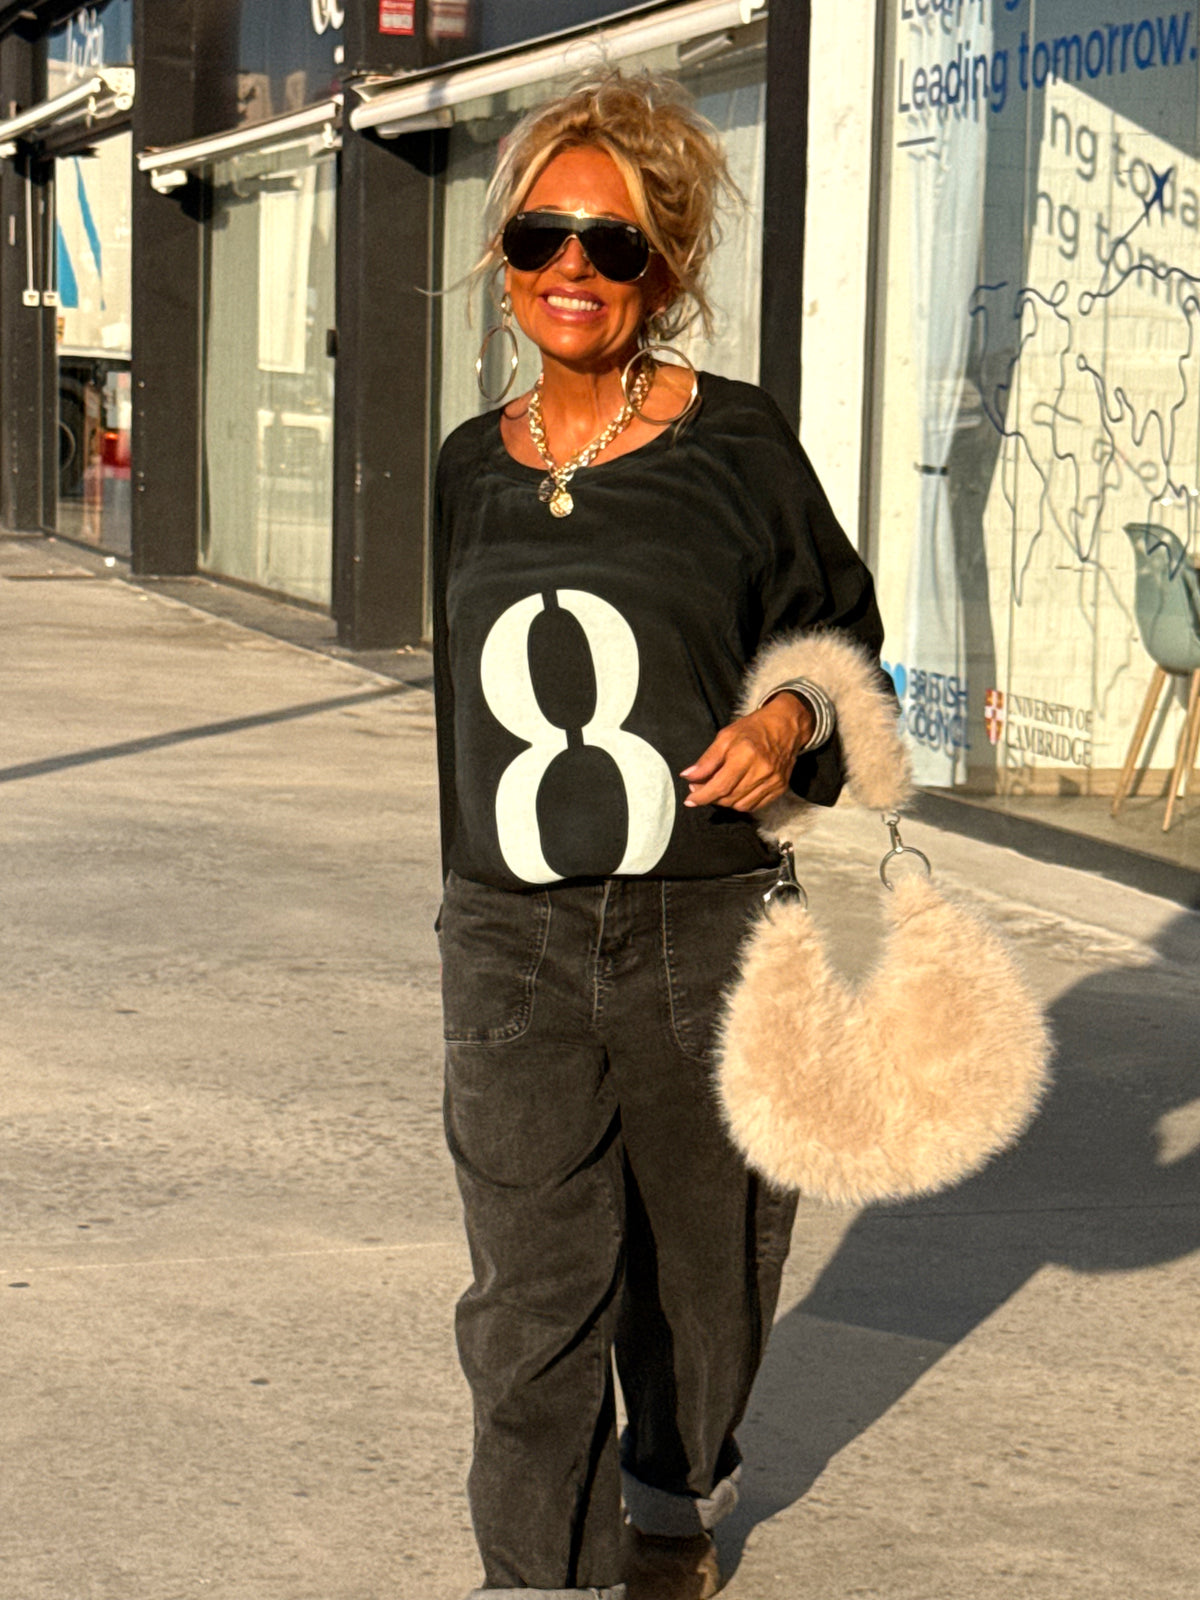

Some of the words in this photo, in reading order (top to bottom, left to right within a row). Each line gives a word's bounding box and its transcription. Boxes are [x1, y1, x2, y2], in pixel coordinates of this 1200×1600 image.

[898, 40, 1008, 113] Leading
[1018, 11, 1197, 91] tomorrow.
[480, 588, 676, 884] 8
